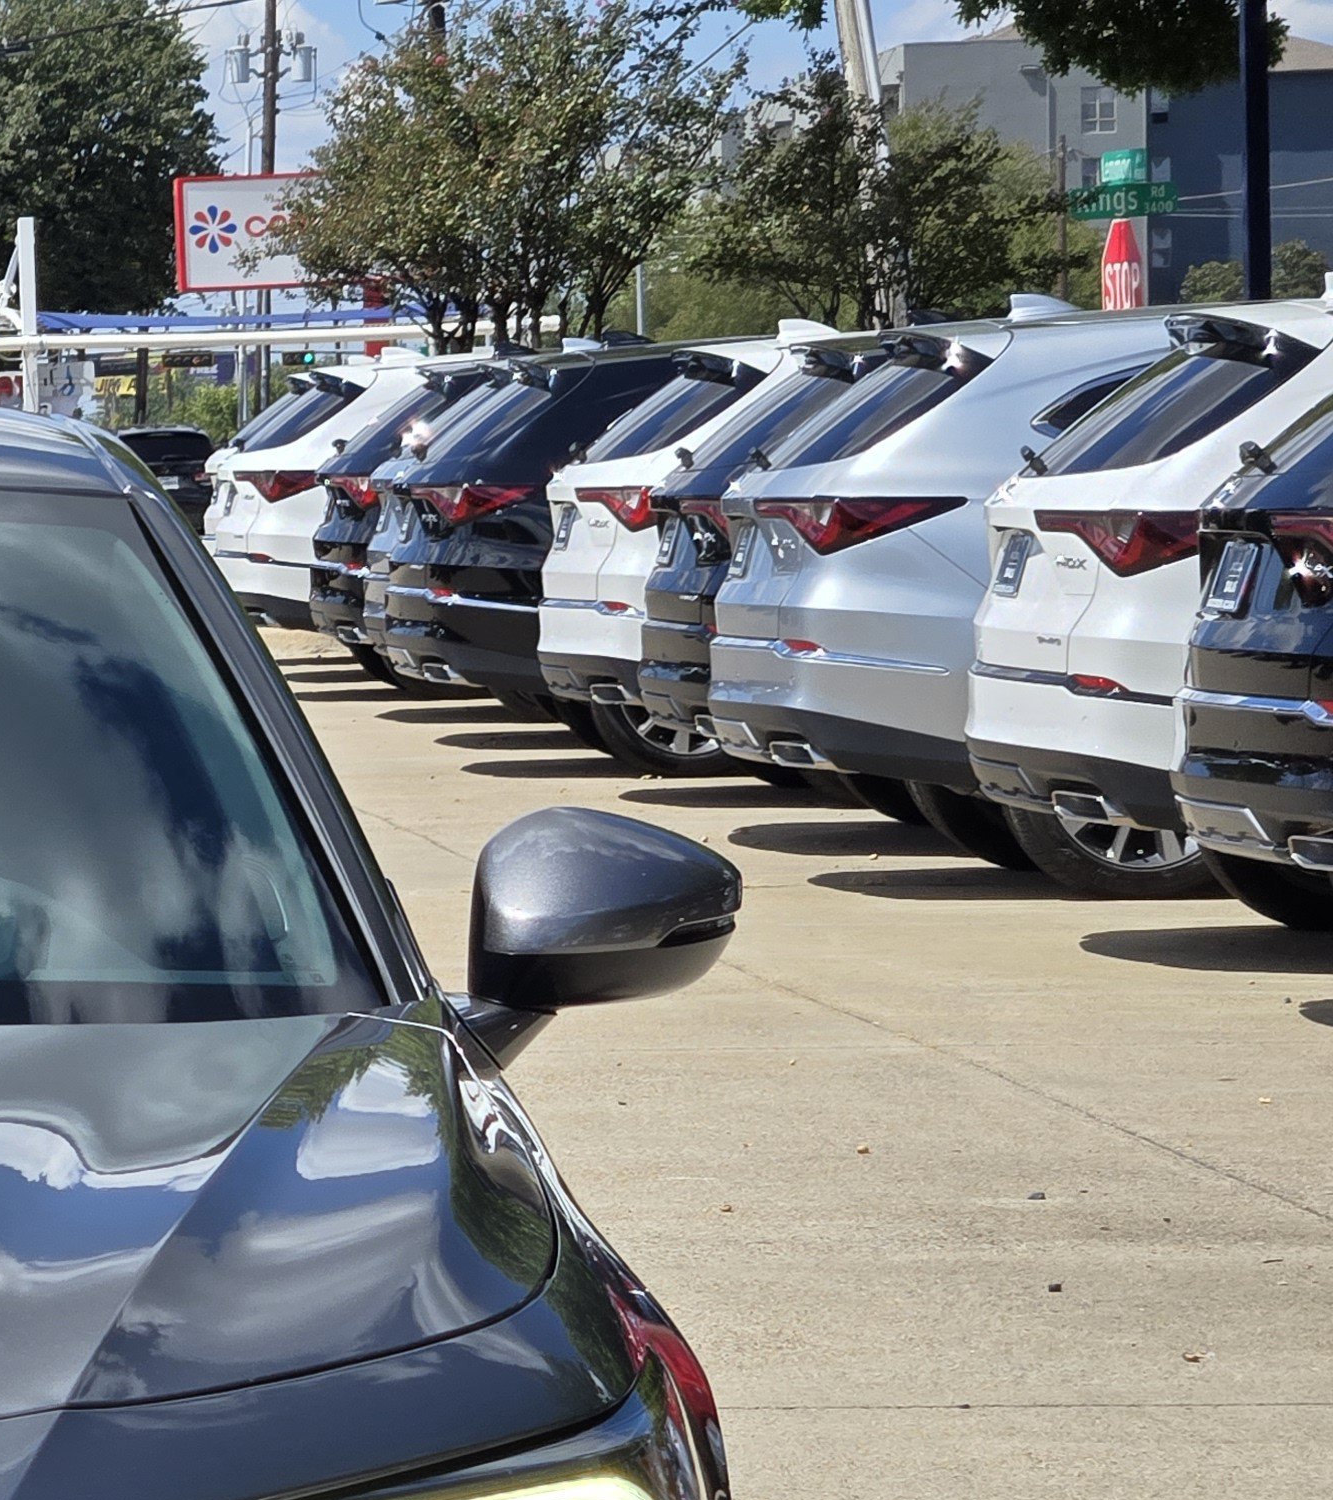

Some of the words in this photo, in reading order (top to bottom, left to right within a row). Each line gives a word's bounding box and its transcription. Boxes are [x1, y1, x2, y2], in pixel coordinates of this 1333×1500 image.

[1151, 185, 1165, 198] Rd
[1144, 201, 1173, 214] 3400
[1105, 262, 1139, 310] STOP
